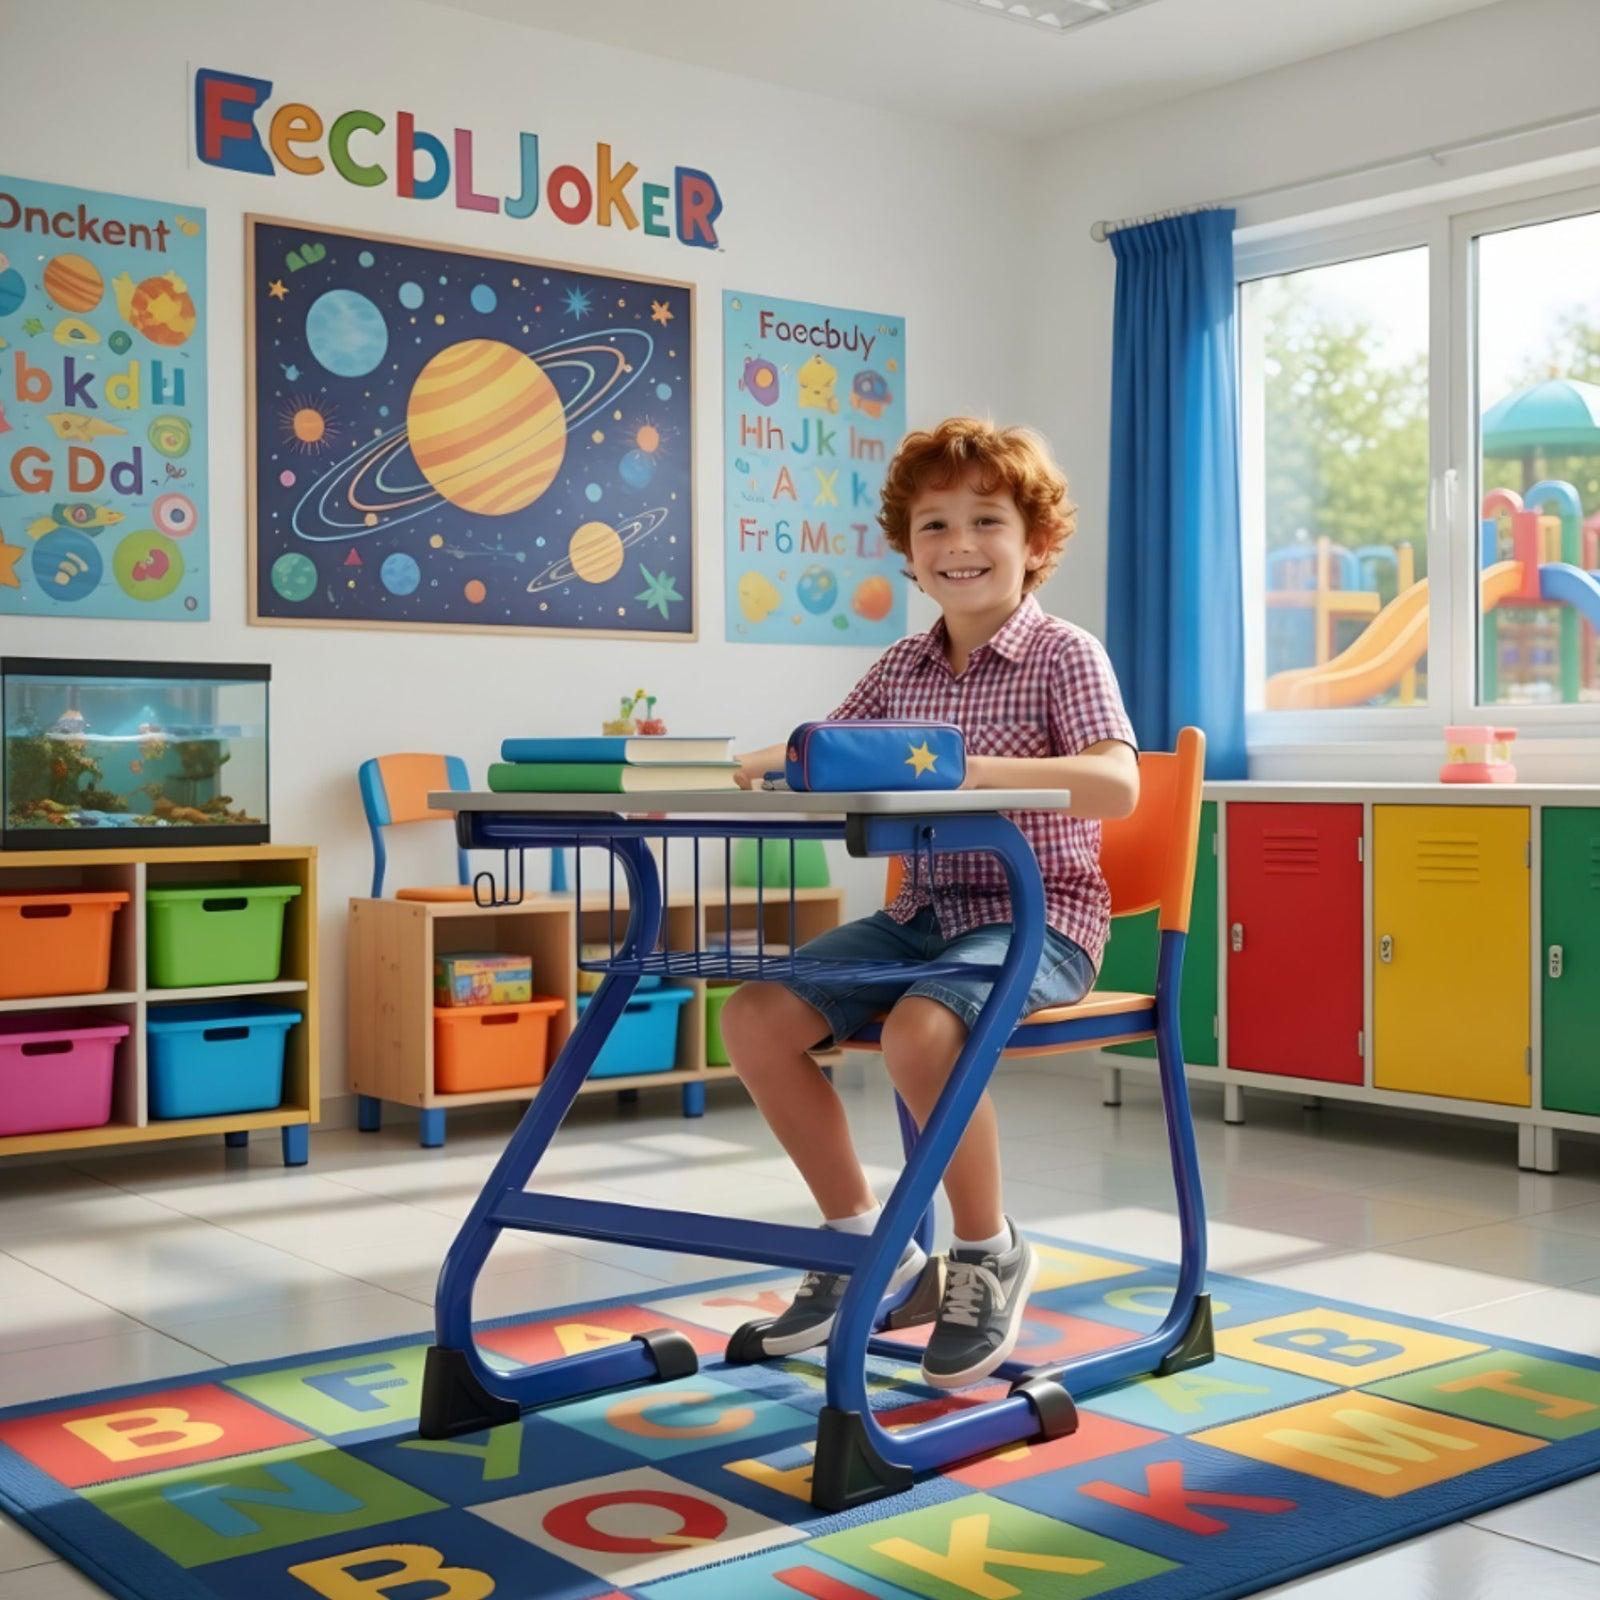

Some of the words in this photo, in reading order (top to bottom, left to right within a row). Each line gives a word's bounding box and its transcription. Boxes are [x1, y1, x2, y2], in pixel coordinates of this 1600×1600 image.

[1253, 1327, 1405, 1367] B
[62, 1407, 224, 1463] B
[605, 1391, 756, 1440] C
[1263, 1410, 1479, 1475] M
[160, 1461, 366, 1538] N
[1079, 1461, 1299, 1535] K
[870, 1513, 1106, 1598] K
